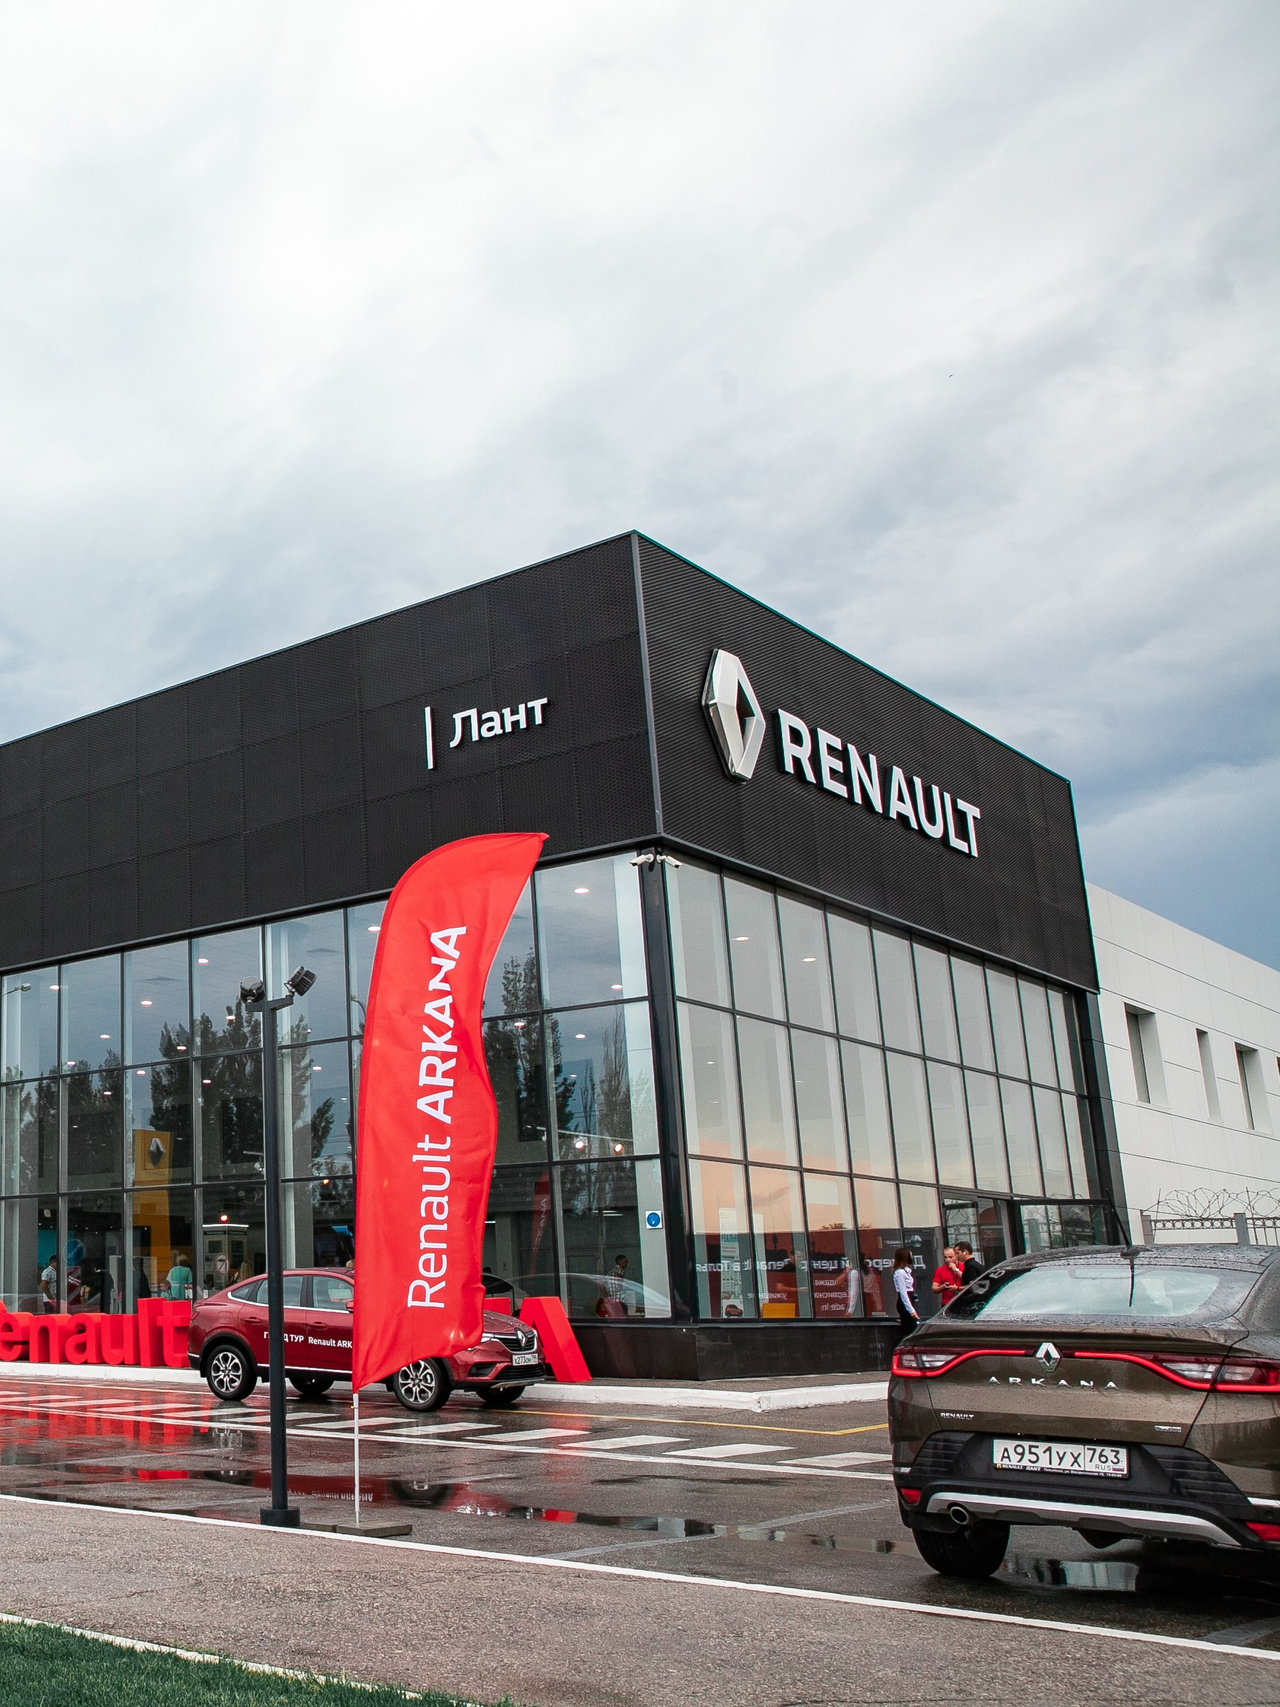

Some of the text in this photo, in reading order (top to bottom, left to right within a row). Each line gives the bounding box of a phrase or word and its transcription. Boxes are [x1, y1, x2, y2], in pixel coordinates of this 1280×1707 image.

[449, 697, 548, 748] Лант
[777, 708, 981, 858] RENAULT
[407, 925, 467, 1309] Renault ARKANA
[289, 1334, 305, 1343] ТУР
[308, 1336, 336, 1347] Renault
[336, 1340, 353, 1348] ARK
[987, 1376, 1120, 1390] ARKANA
[940, 1412, 975, 1420] RENAULT
[1086, 1447, 1121, 1465] 763
[1095, 1463, 1112, 1471] RUS
